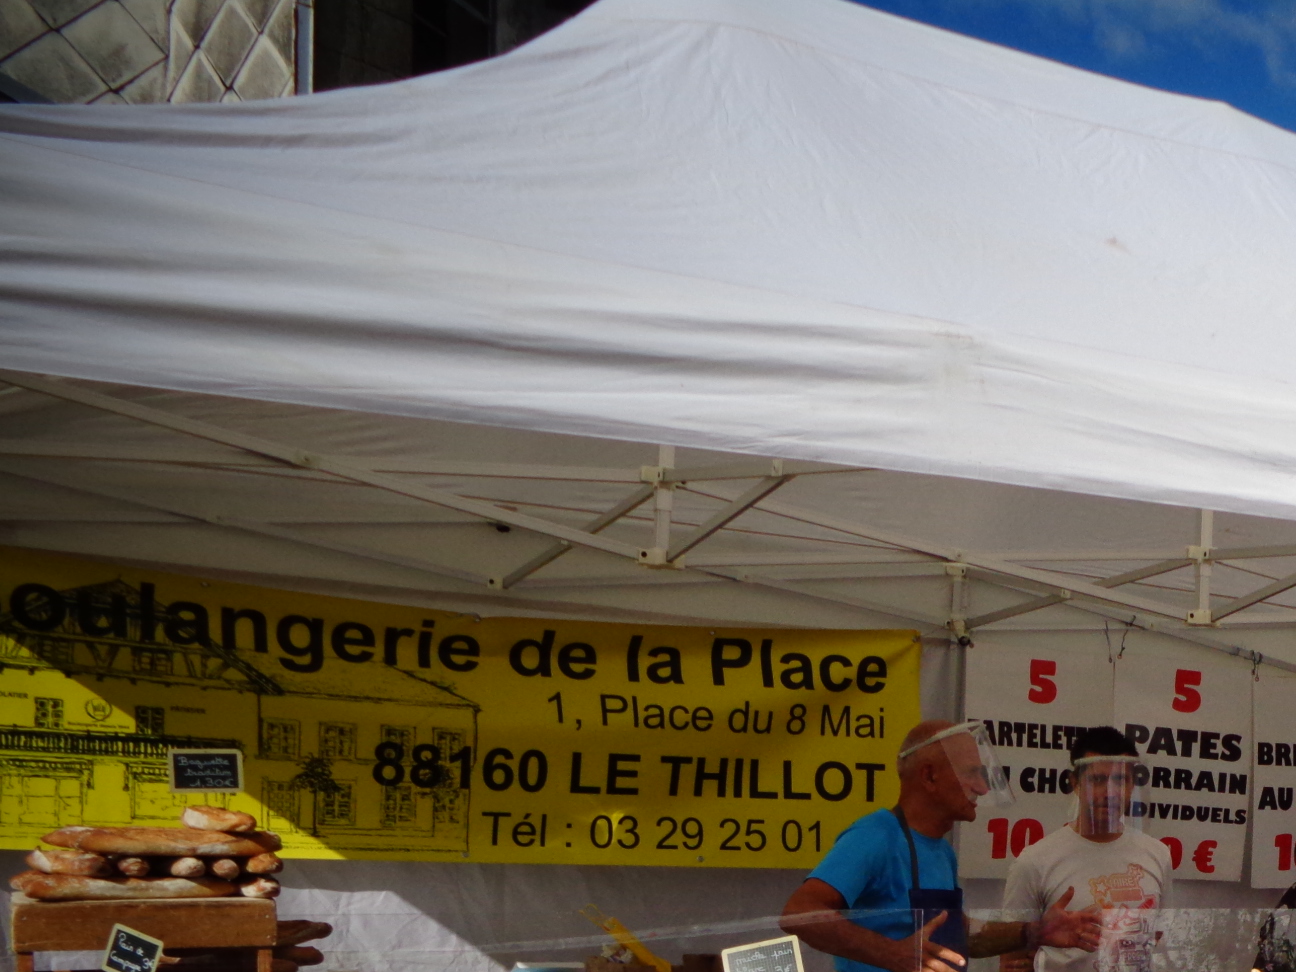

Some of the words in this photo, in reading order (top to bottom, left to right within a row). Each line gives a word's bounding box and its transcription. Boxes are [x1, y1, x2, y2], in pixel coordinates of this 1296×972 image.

[10, 582, 480, 672] oulangerie
[509, 630, 596, 680] de
[626, 635, 684, 685] la
[711, 638, 887, 693] Place
[1028, 659, 1057, 704] 5
[1172, 669, 1201, 712] 5
[548, 693, 582, 731] 1,
[601, 694, 714, 733] Place
[728, 701, 772, 735] du
[786, 704, 806, 736] 8
[820, 705, 885, 738] Mai
[1125, 723, 1242, 762] PATES
[178, 756, 230, 769] Baguette
[373, 742, 548, 793] 88160
[570, 752, 641, 796] LE
[661, 756, 886, 803] THILLOT
[1020, 767, 1075, 794] CHO
[1132, 764, 1247, 795] ORRAIN
[1124, 801, 1247, 825] DIVIDUELS
[1258, 787, 1293, 811] AU
[482, 811, 546, 848] Tél
[590, 815, 640, 850] 03
[656, 817, 703, 851] 29
[719, 819, 767, 852] 25
[781, 820, 822, 853] 01
[1192, 840, 1217, 873] €
